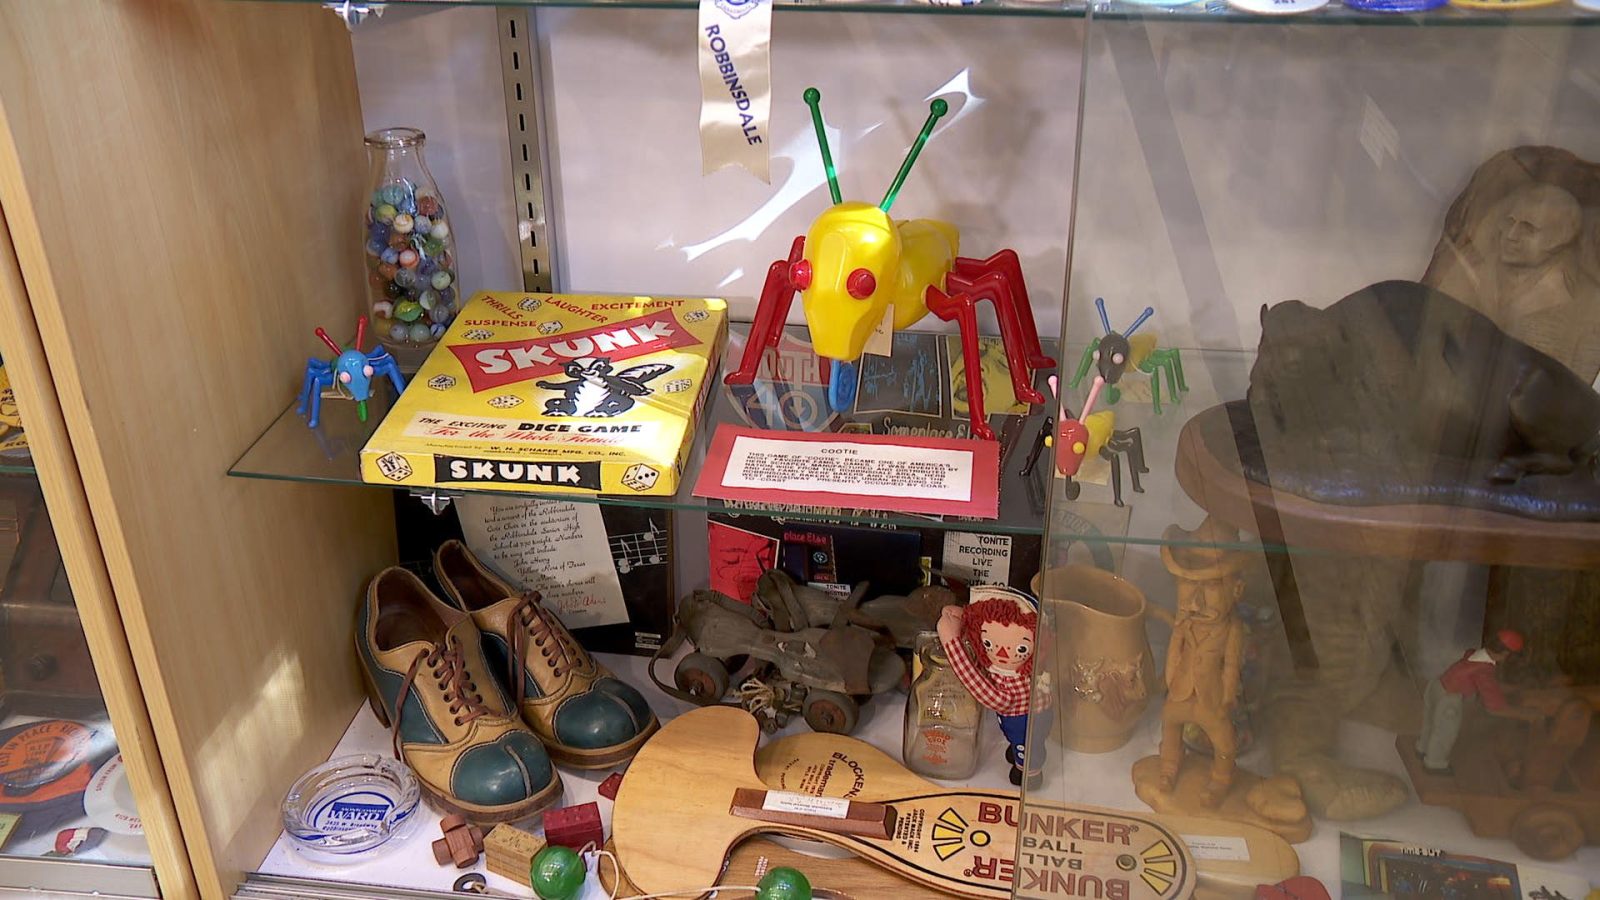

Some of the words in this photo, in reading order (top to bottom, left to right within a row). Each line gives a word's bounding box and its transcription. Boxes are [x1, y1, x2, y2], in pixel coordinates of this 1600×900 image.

[705, 24, 763, 146] ROBBINSDALE
[481, 295, 524, 320] THRILLS
[544, 296, 608, 324] LAUGHTER
[591, 299, 685, 311] EXCITEMENT
[464, 319, 537, 328] SUSPENSE
[475, 320, 676, 375] SKUNK
[418, 416, 443, 425] THE
[448, 420, 508, 430] EXCITING
[517, 422, 572, 432] DICE
[578, 424, 643, 433] GAME
[467, 428, 496, 439] the
[502, 430, 556, 442] Whole
[450, 460, 581, 485] SKUNK
[978, 535, 1010, 546] TONITE
[958, 545, 1008, 557] RECORDING
[972, 558, 993, 567] LIVE
[973, 568, 989, 577] THE
[331, 810, 381, 821] WARD
[978, 801, 1130, 846] BUNKER
[1022, 836, 1083, 854] BALL
[1022, 851, 1082, 870] BALL
